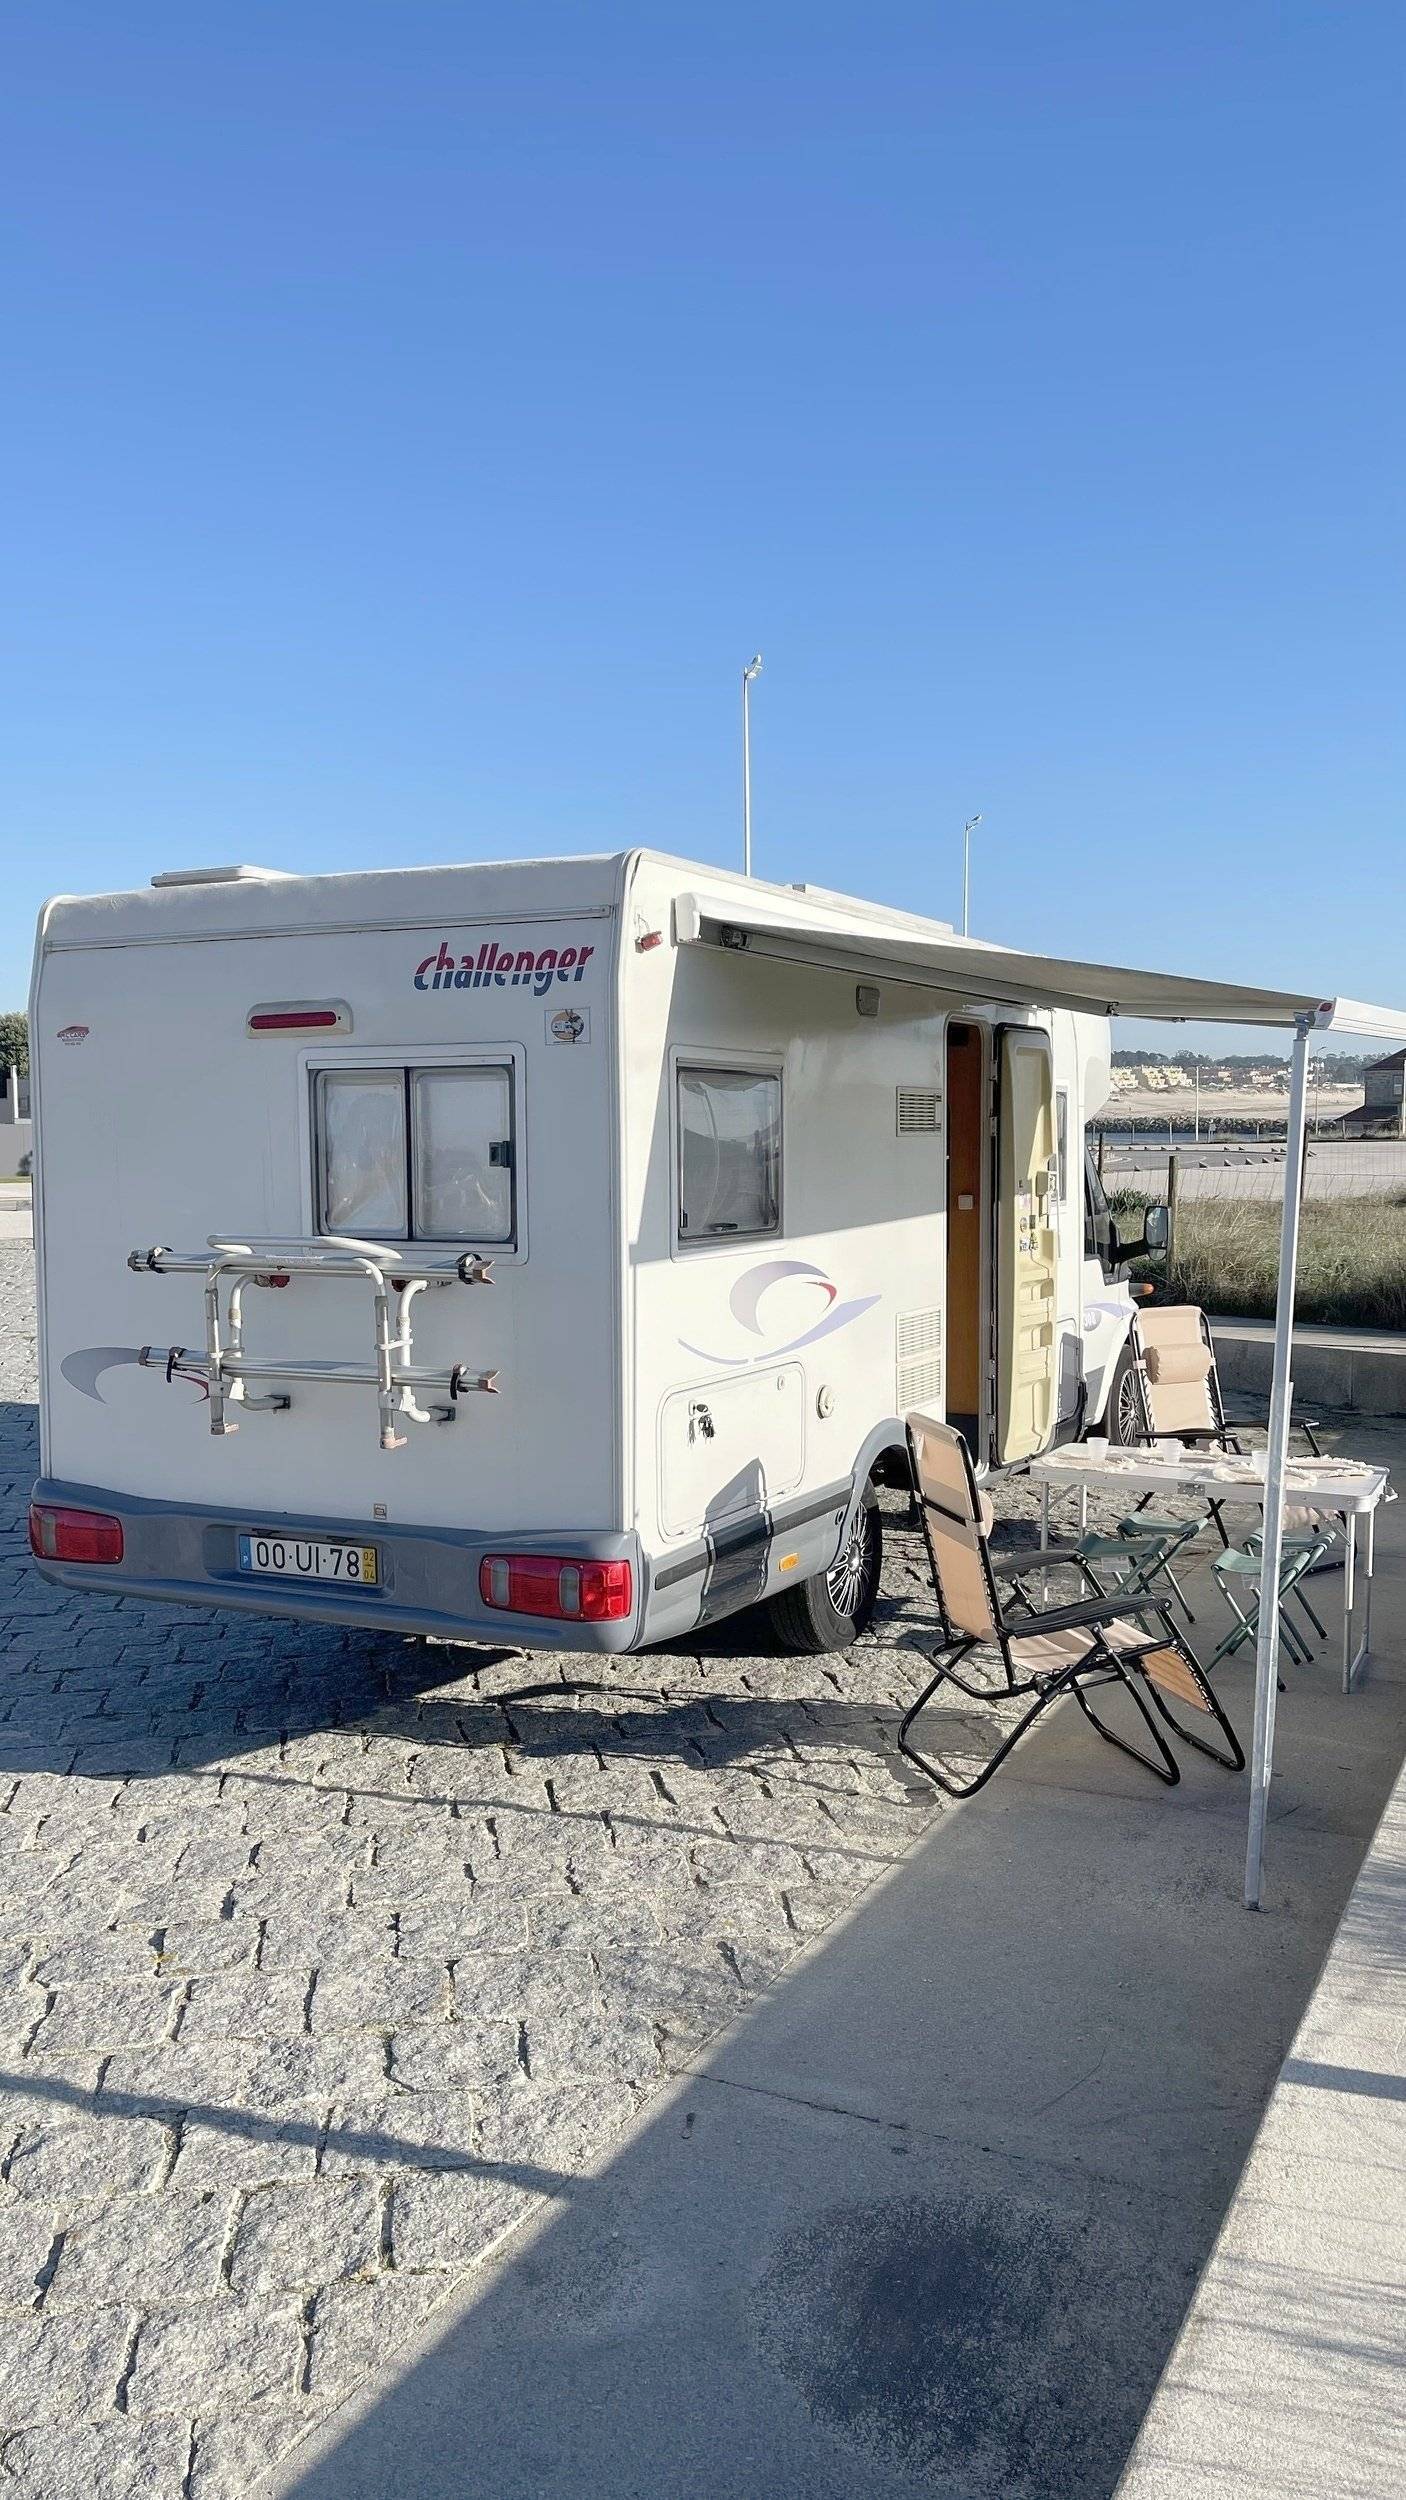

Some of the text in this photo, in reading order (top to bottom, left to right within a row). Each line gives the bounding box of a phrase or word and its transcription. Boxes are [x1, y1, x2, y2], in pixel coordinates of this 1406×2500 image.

[413, 941, 595, 997] challenger
[363, 1551, 375, 1563] 02
[363, 1569, 375, 1580] 04
